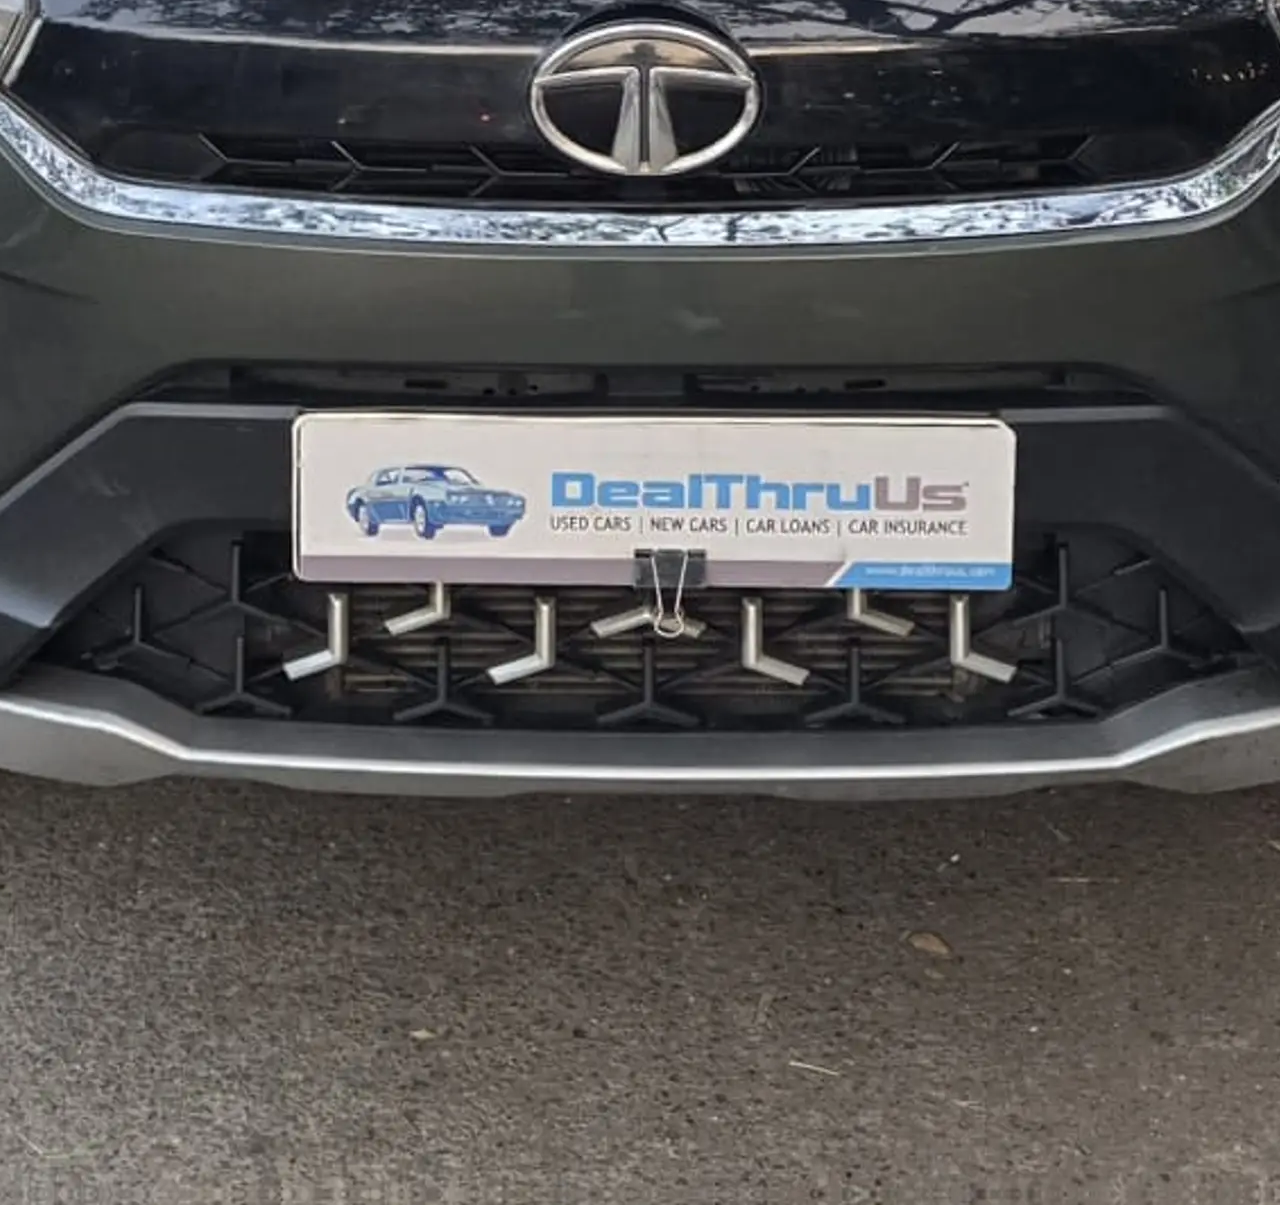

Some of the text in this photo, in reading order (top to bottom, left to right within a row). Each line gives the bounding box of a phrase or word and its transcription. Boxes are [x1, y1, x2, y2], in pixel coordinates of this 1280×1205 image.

[551, 472, 968, 511] DealThruUs
[550, 515, 969, 536] USED CARS NEW CARS CAR LOANS CAR INSURANCE
